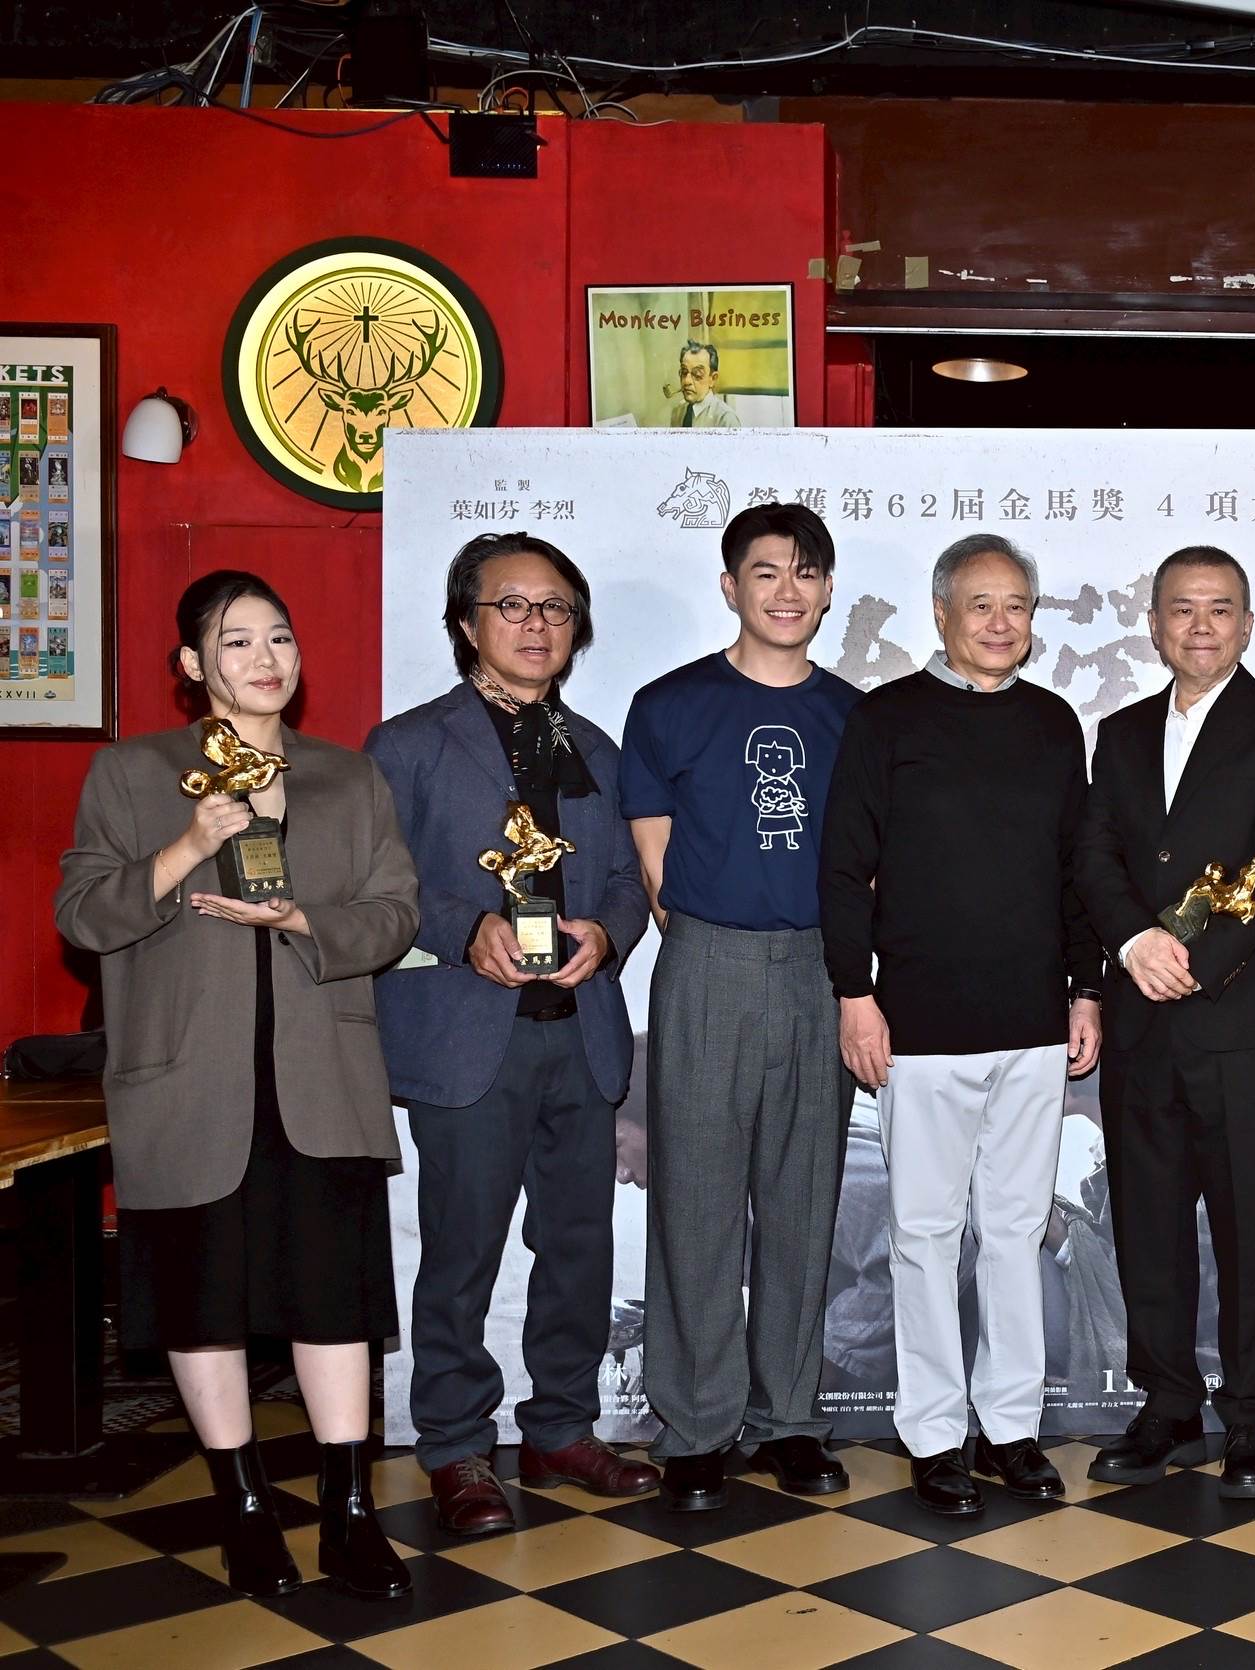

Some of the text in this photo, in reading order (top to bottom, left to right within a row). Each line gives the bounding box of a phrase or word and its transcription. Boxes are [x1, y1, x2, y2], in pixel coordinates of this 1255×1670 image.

[599, 308, 781, 330] Monkey Business
[0, 365, 65, 382] KETS
[494, 479, 530, 492] 監製
[450, 499, 575, 520] 葉如芬 李烈
[1157, 493, 1175, 517] 4
